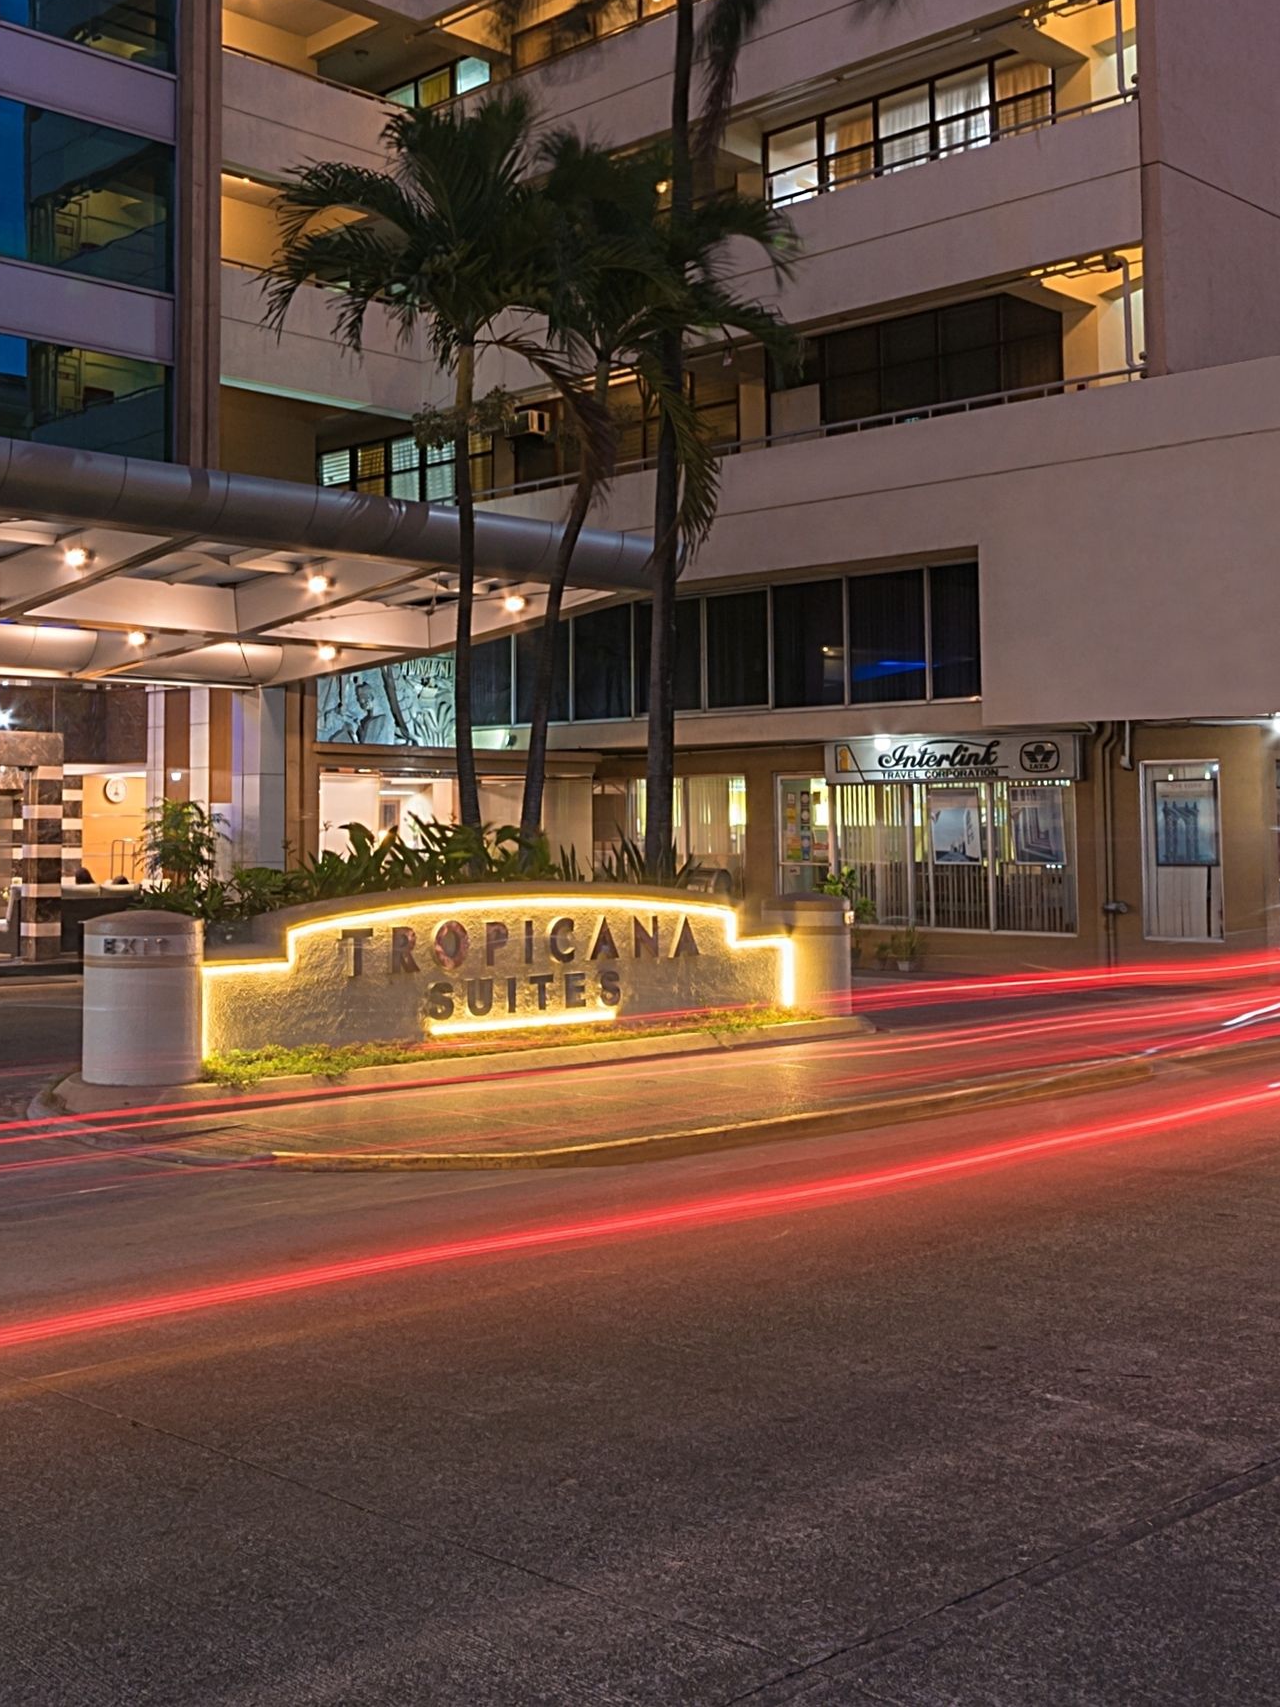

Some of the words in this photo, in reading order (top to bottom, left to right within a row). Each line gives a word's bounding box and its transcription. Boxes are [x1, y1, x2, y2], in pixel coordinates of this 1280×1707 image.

[878, 739, 1000, 769] Interlink
[882, 770, 920, 780] TRAVEL
[924, 768, 999, 779] CORPORATION
[104, 937, 170, 955] EXIT
[337, 915, 700, 978] TROPICANA
[426, 971, 621, 1021] SUITES
